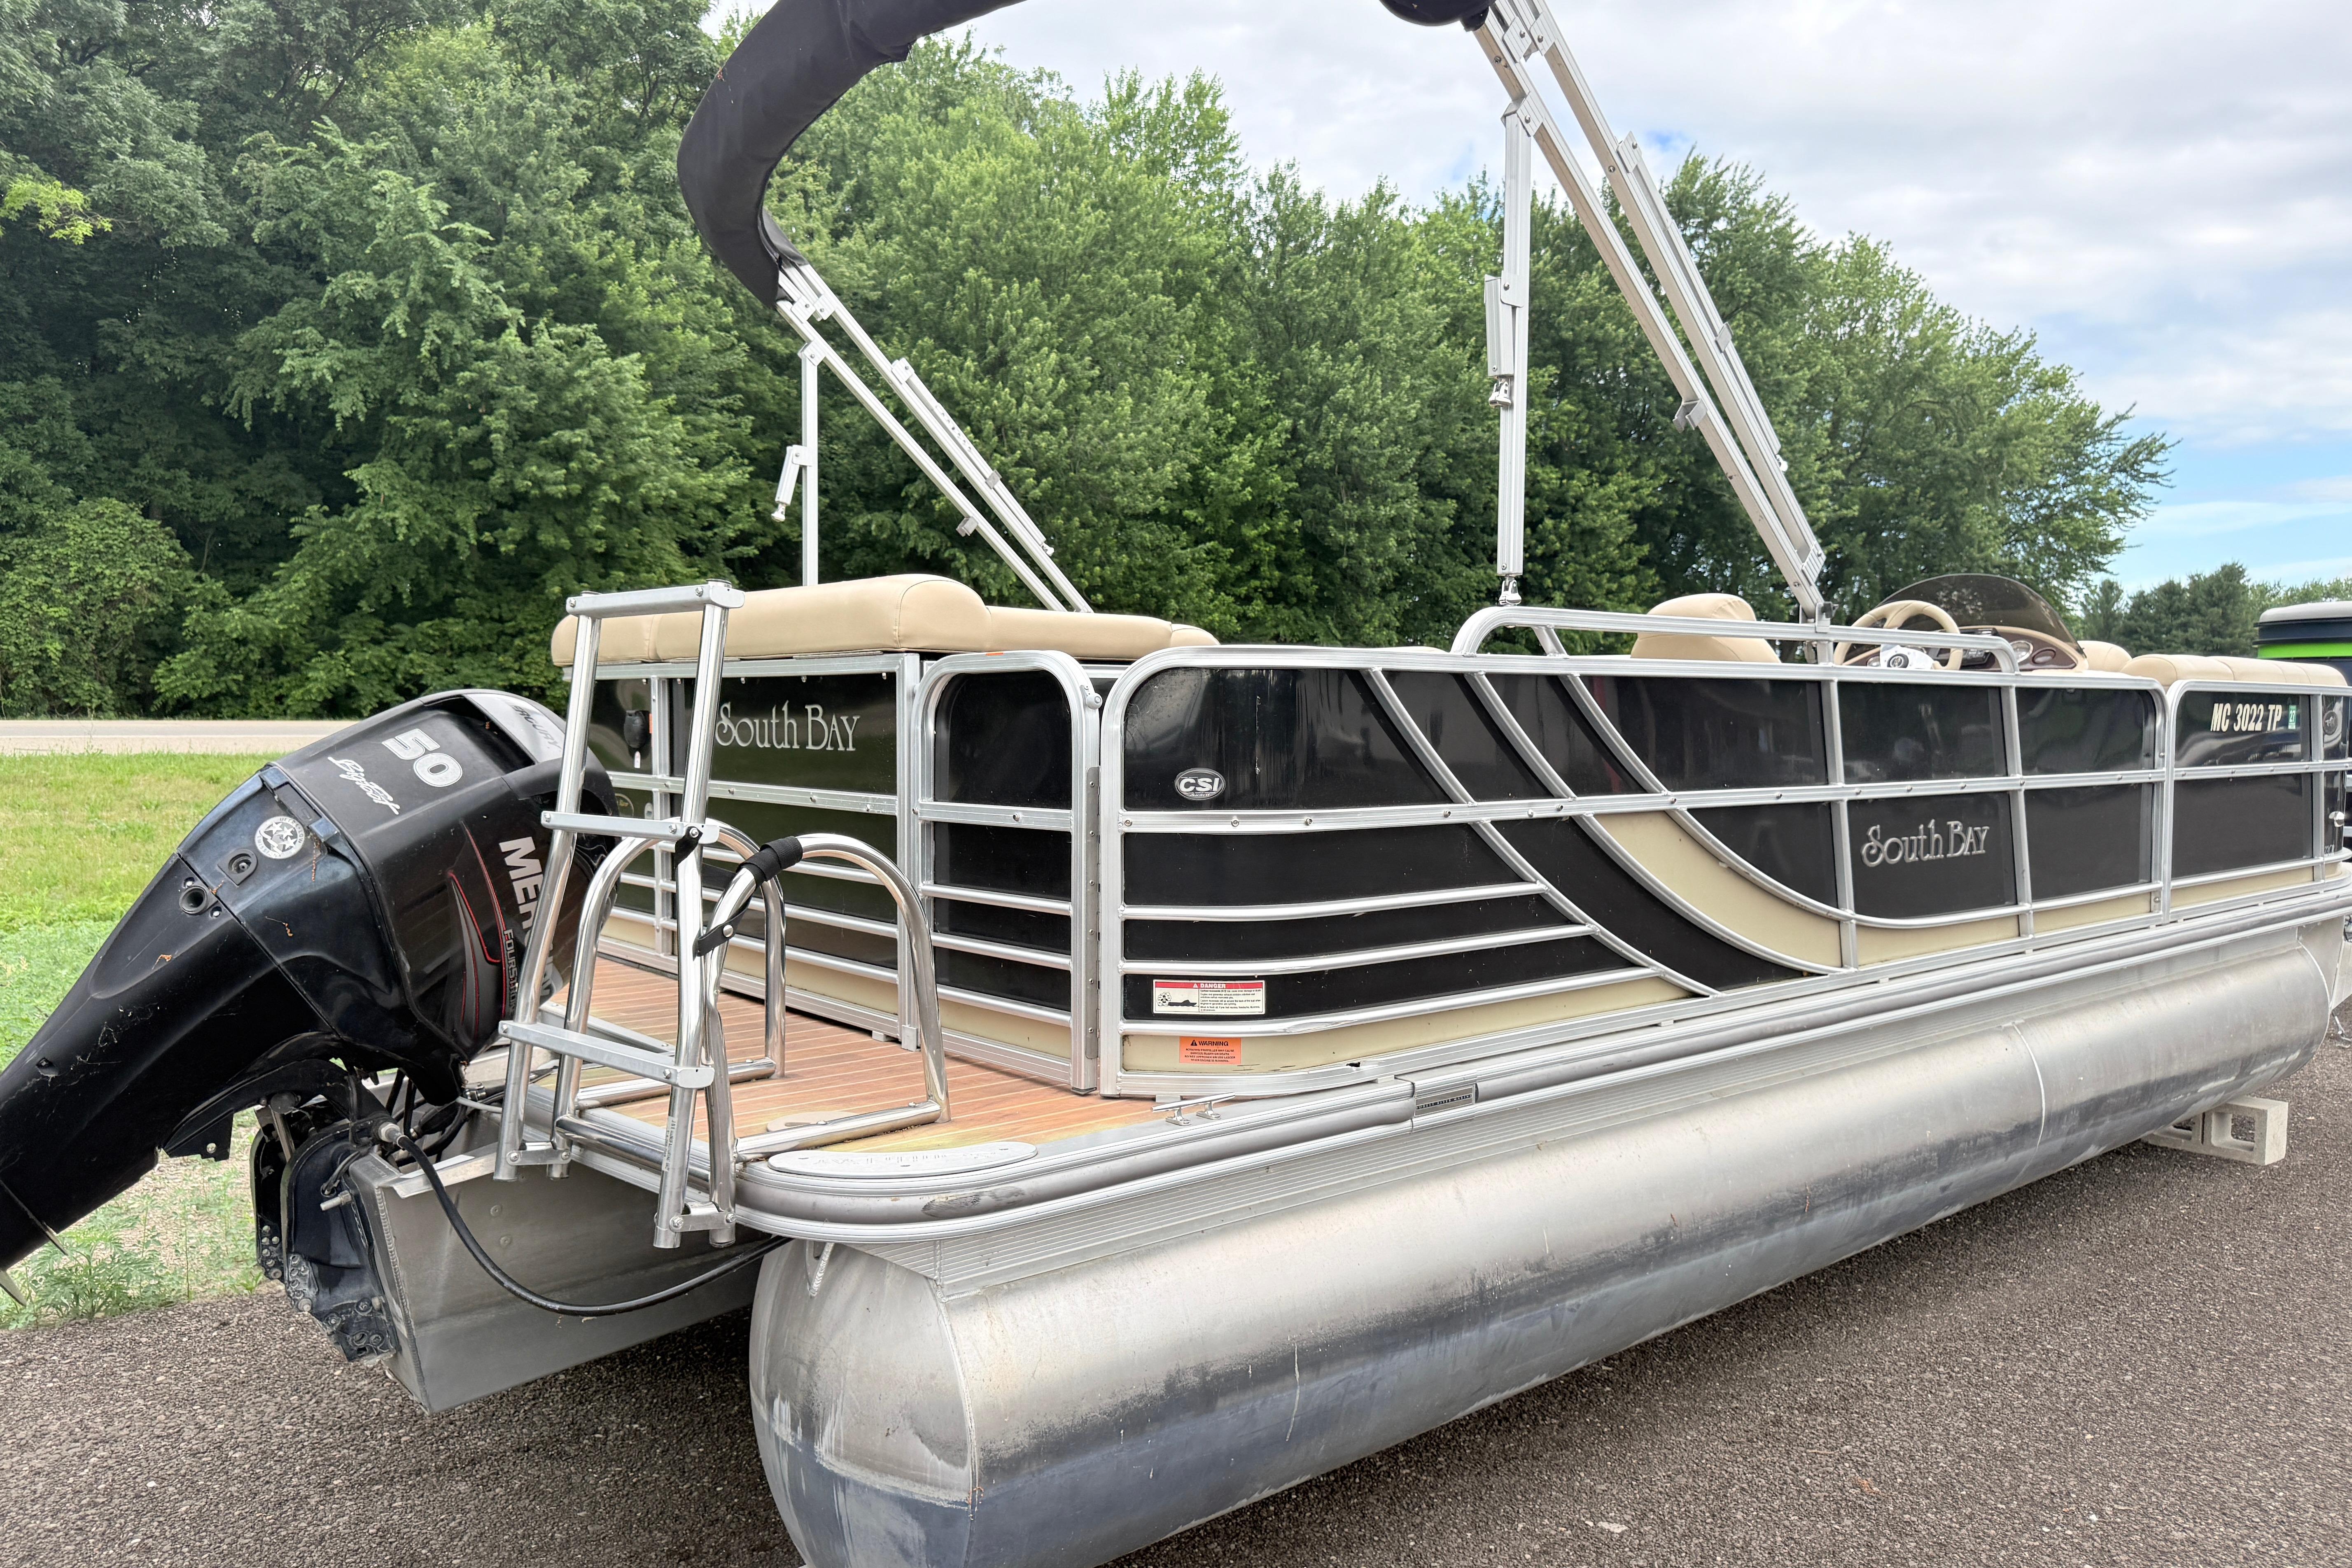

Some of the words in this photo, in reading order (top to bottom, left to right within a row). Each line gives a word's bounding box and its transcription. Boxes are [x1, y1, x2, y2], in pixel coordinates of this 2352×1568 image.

[507, 703, 562, 749] ERCURY
[715, 700, 800, 749] South
[2210, 703, 2231, 732] MC
[2233, 703, 2264, 731] 3022
[2267, 705, 2282, 731] TP
[2289, 710, 2296, 722] 27
[381, 728, 463, 787] 50
[327, 756, 400, 815] Bigfoot
[1179, 778, 1219, 792] CSI
[1861, 819, 1944, 867] South
